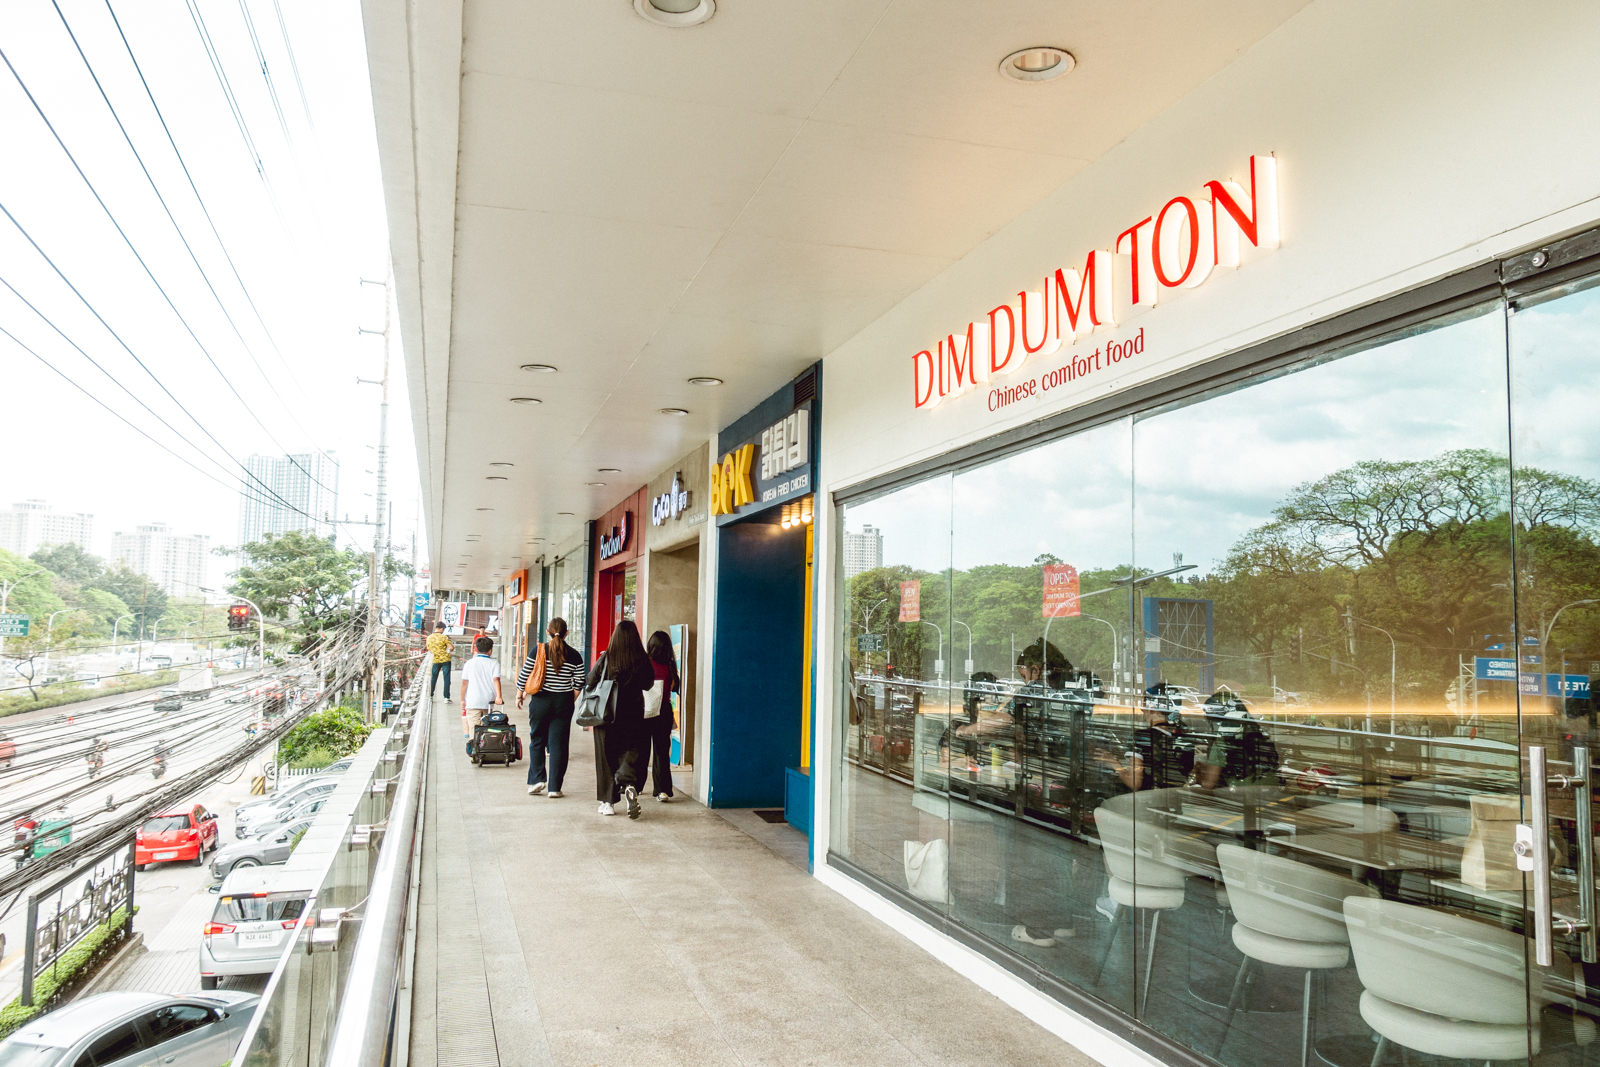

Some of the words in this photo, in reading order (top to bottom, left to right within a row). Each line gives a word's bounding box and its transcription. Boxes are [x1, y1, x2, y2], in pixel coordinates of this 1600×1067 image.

[911, 321, 977, 408] DIM
[987, 249, 1102, 373] DUM
[1116, 154, 1258, 305] TON
[988, 378, 1037, 412] Chinese
[1041, 347, 1101, 389] comfort
[1106, 327, 1144, 367] food
[778, 482, 789, 497] FRIED
[791, 474, 808, 492] CHICKEN
[1050, 571, 1071, 586] OPEN
